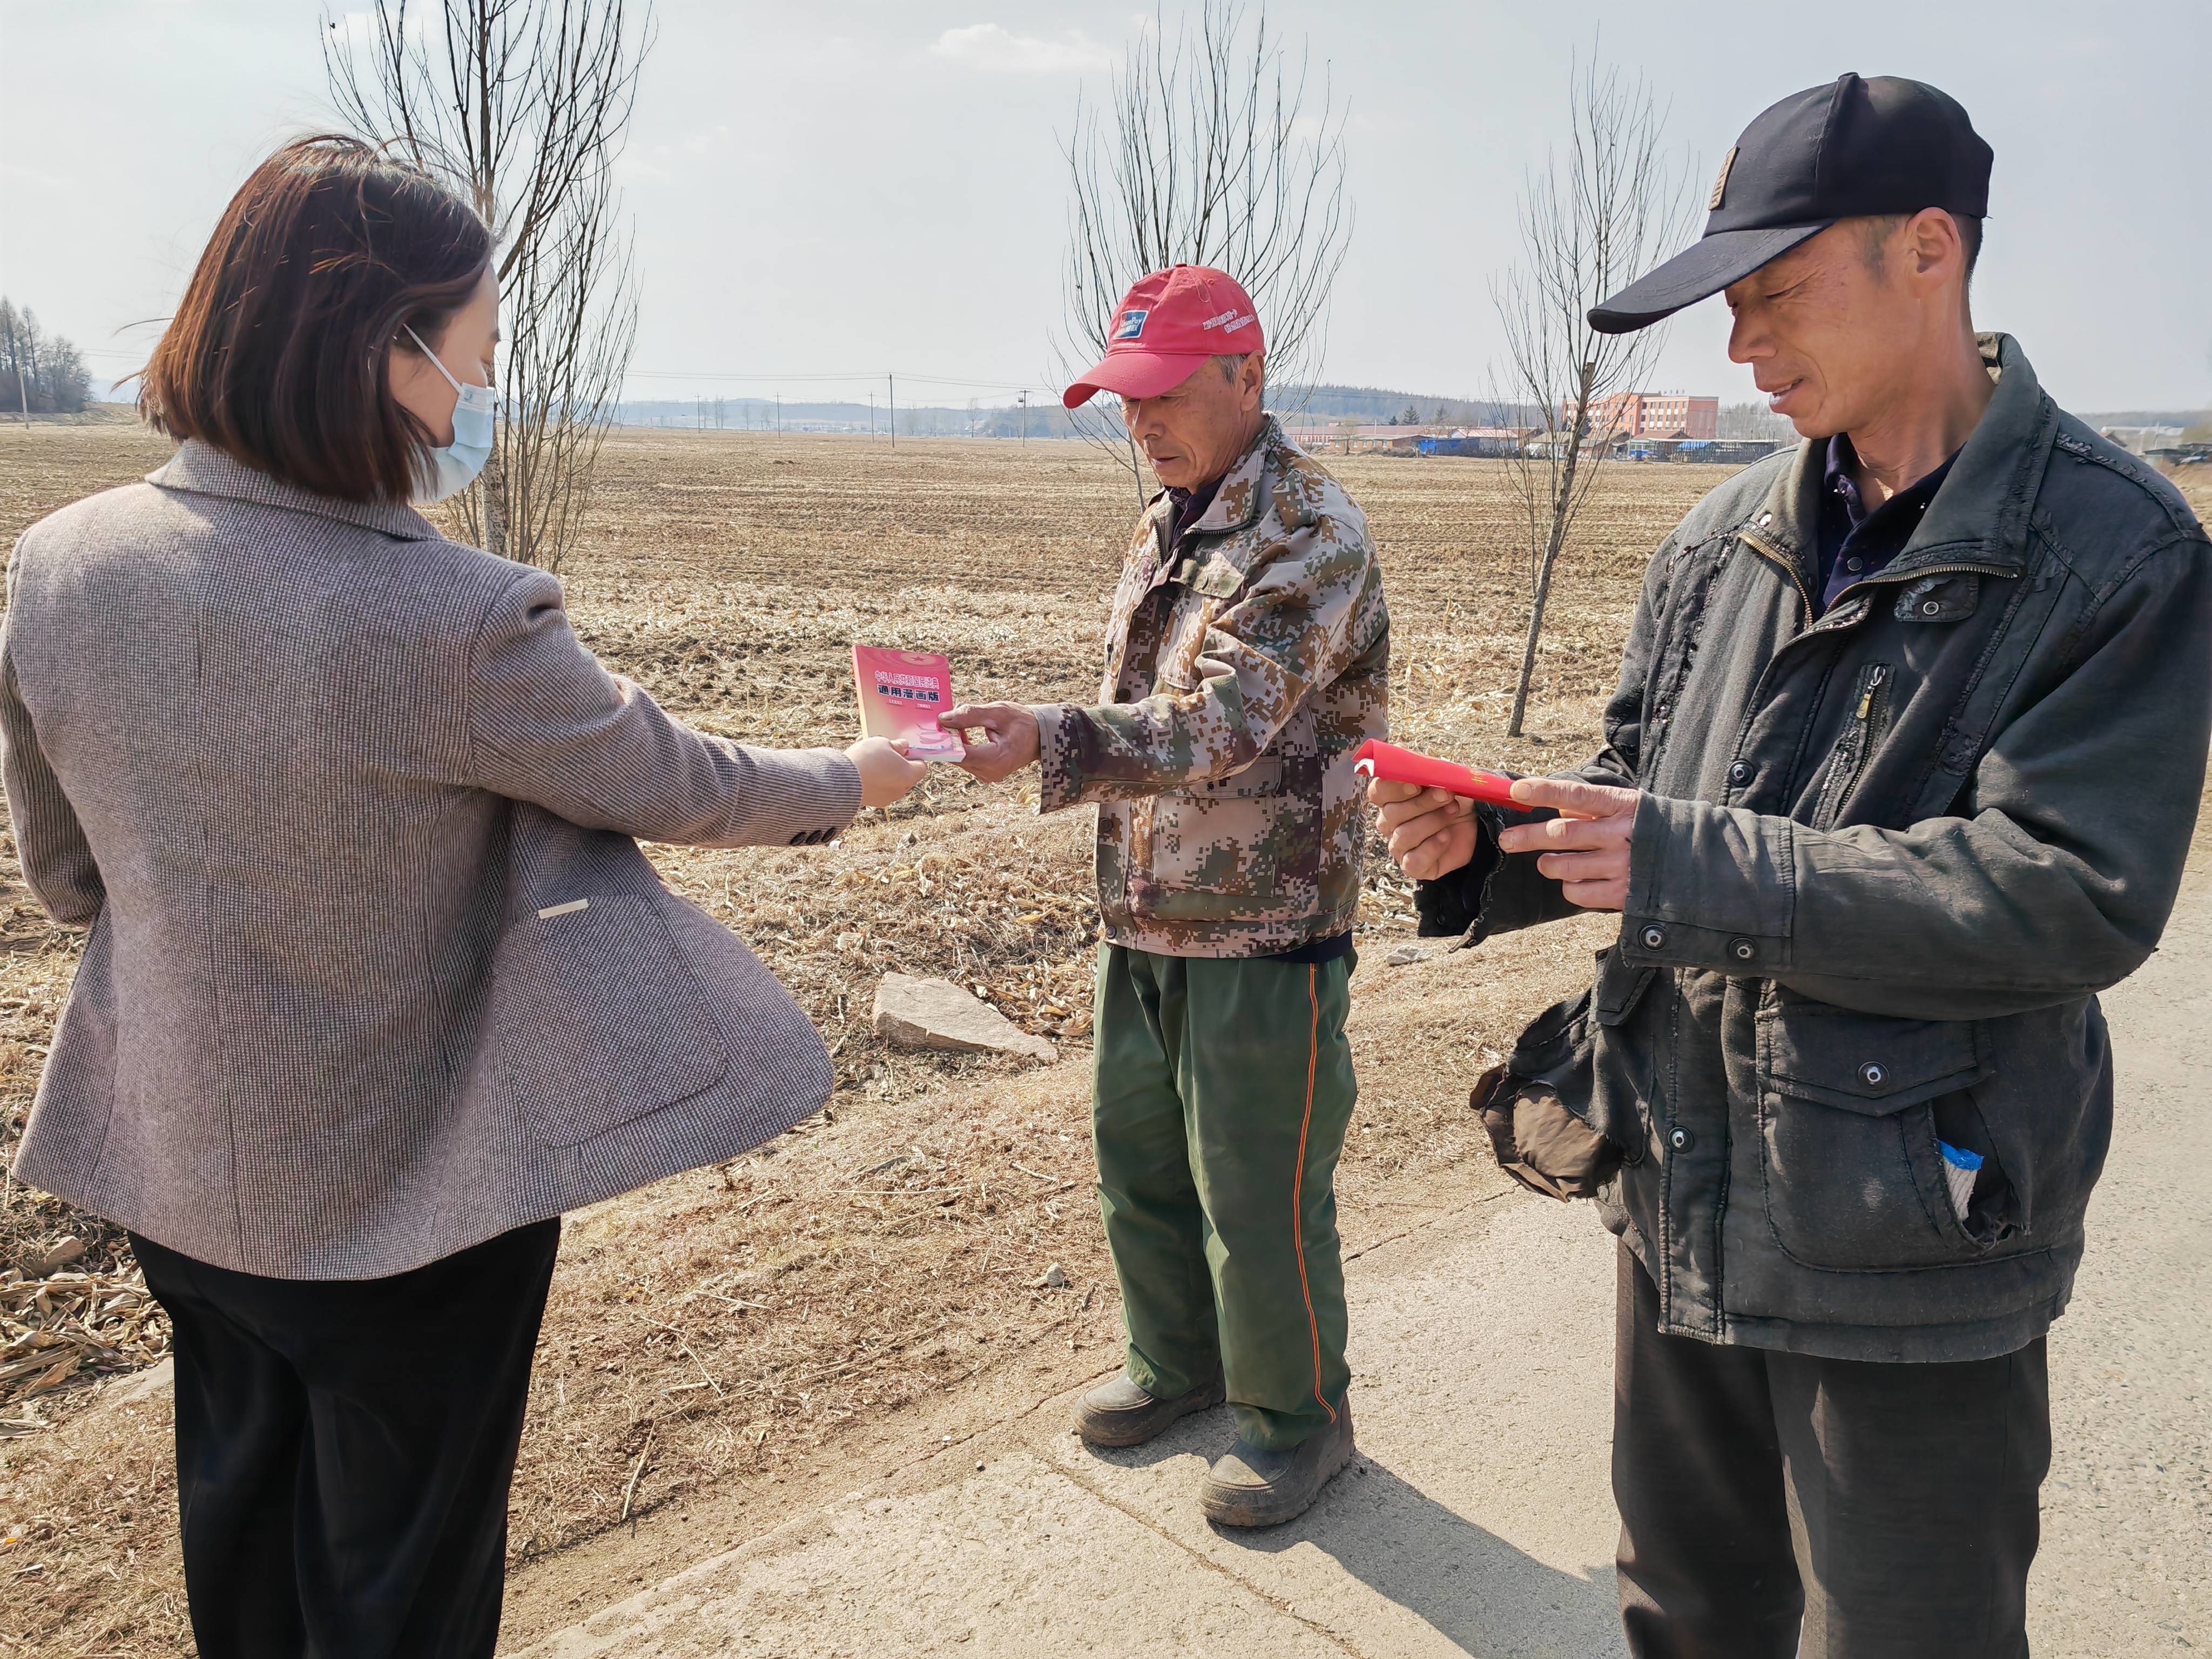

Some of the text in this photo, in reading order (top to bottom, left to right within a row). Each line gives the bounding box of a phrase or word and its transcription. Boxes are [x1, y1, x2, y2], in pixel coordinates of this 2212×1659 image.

[878, 684, 940, 702] 通用漫画版
